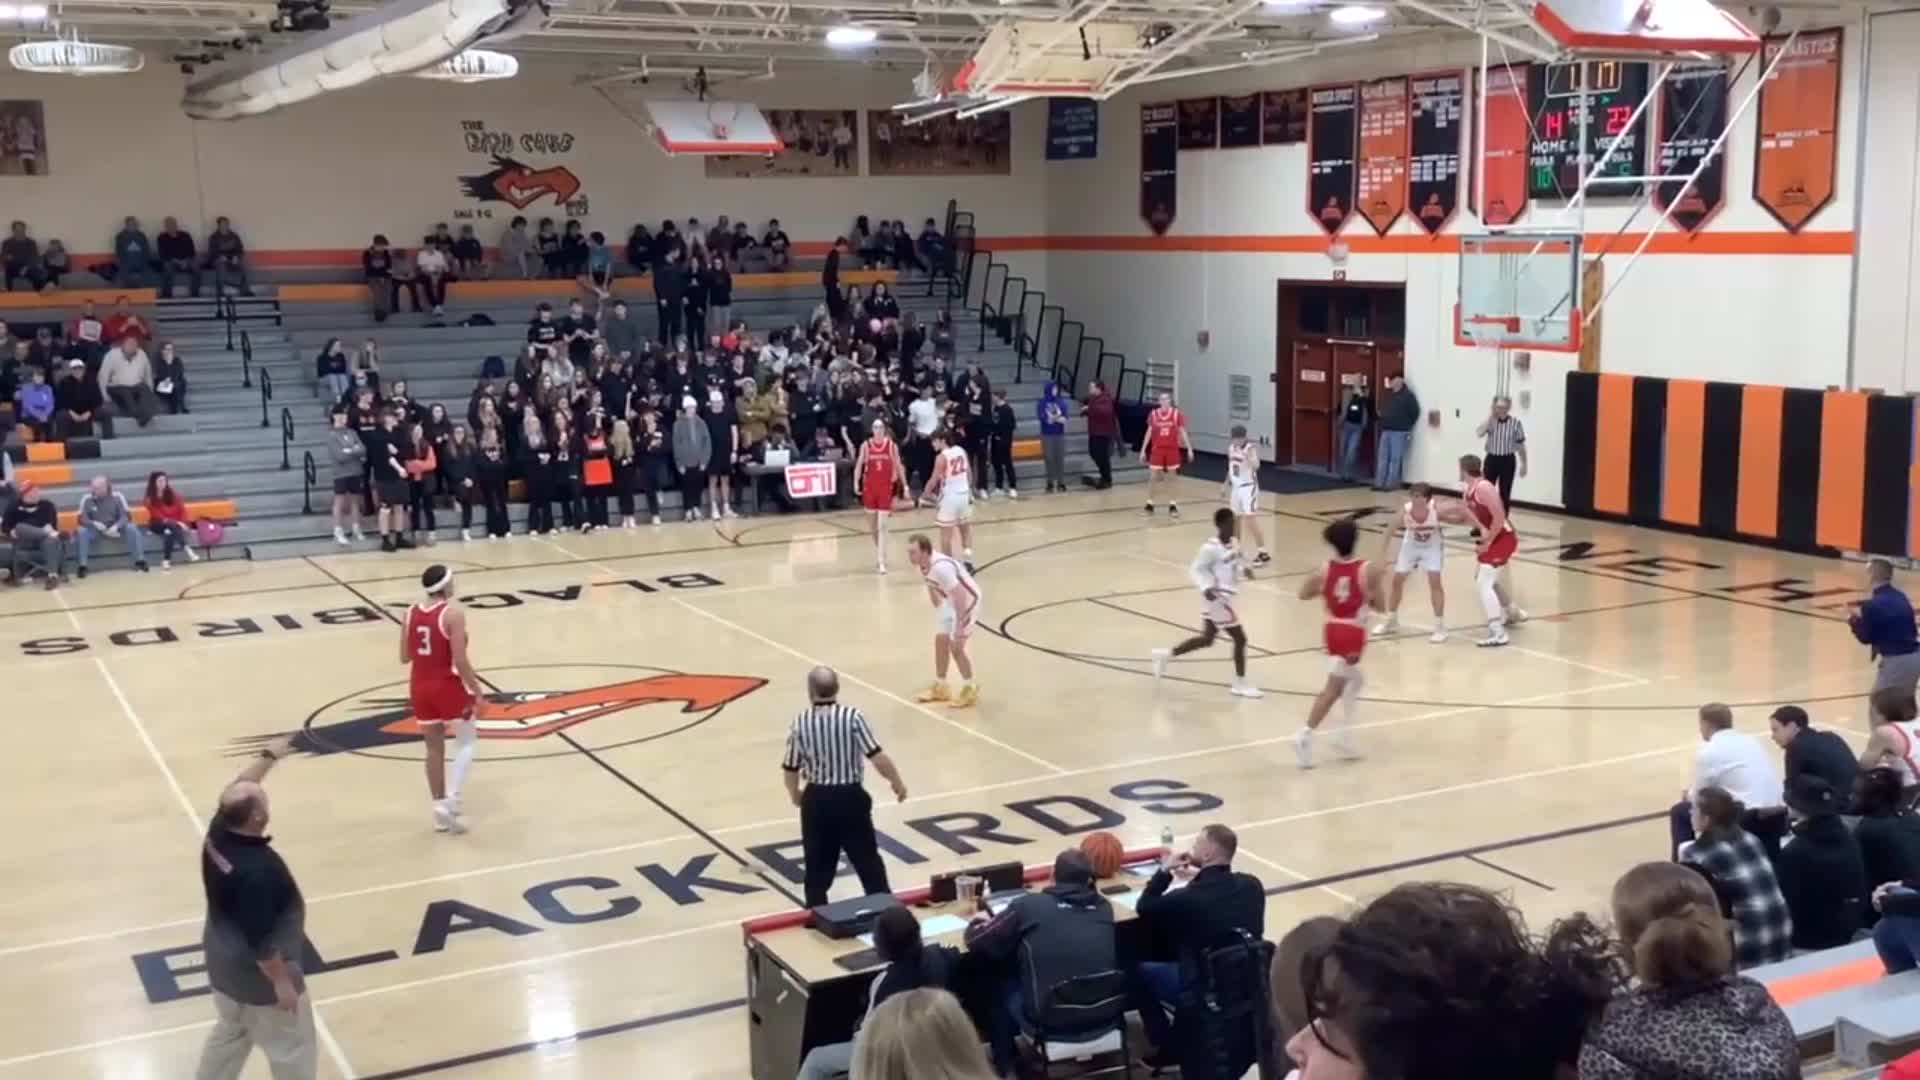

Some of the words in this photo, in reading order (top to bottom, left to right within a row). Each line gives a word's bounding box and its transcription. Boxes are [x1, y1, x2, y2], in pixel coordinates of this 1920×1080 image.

[462, 120, 482, 131] THE
[1545, 111, 1562, 138] 14
[1531, 140, 1568, 154] HOME
[949, 455, 968, 476] 22
[1333, 575, 1351, 603] 4
[416, 625, 432, 656] 3
